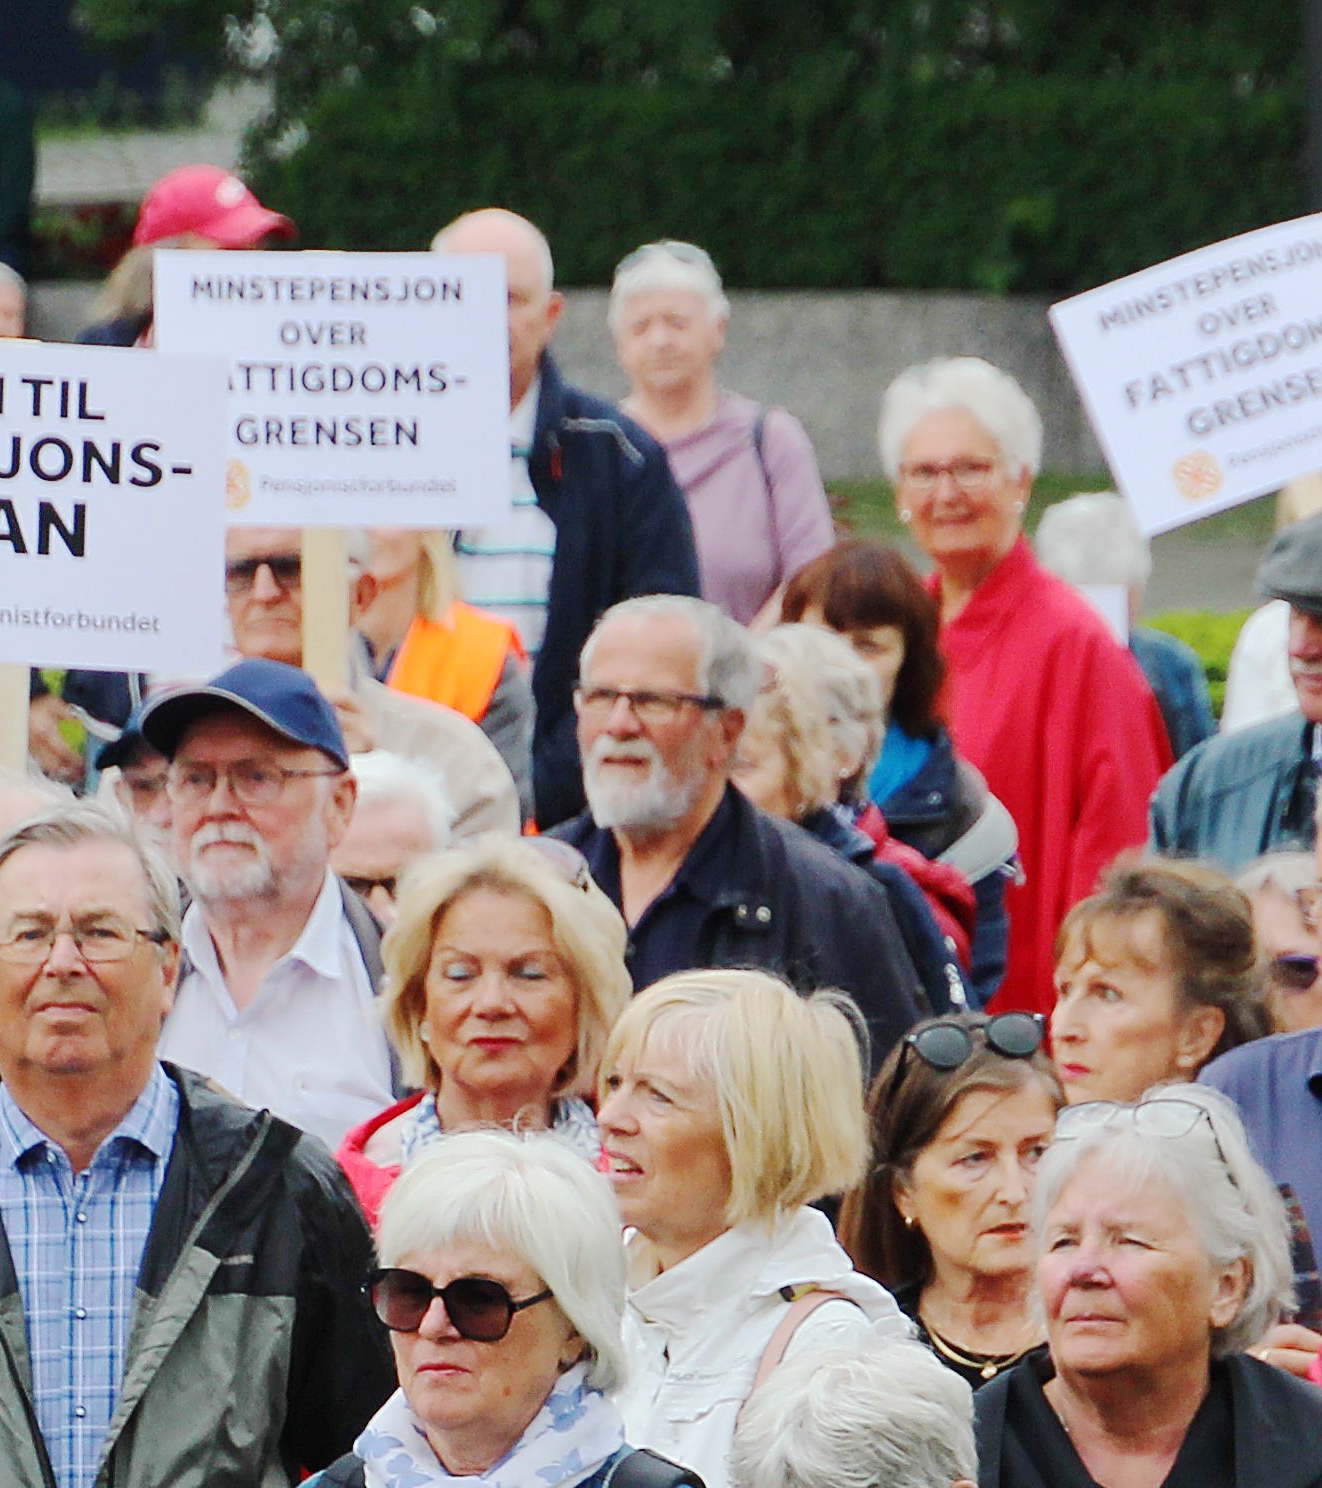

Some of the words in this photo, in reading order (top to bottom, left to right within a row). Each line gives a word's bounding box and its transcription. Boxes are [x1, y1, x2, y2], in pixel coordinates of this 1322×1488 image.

[191, 276, 464, 304] MINSTEPENSJON
[1196, 292, 1279, 337] OVER
[279, 320, 367, 347] OVER
[227, 362, 468, 393] TTIGDOMS-
[20, 377, 106, 421] TIL
[235, 417, 419, 447] GRENSEN
